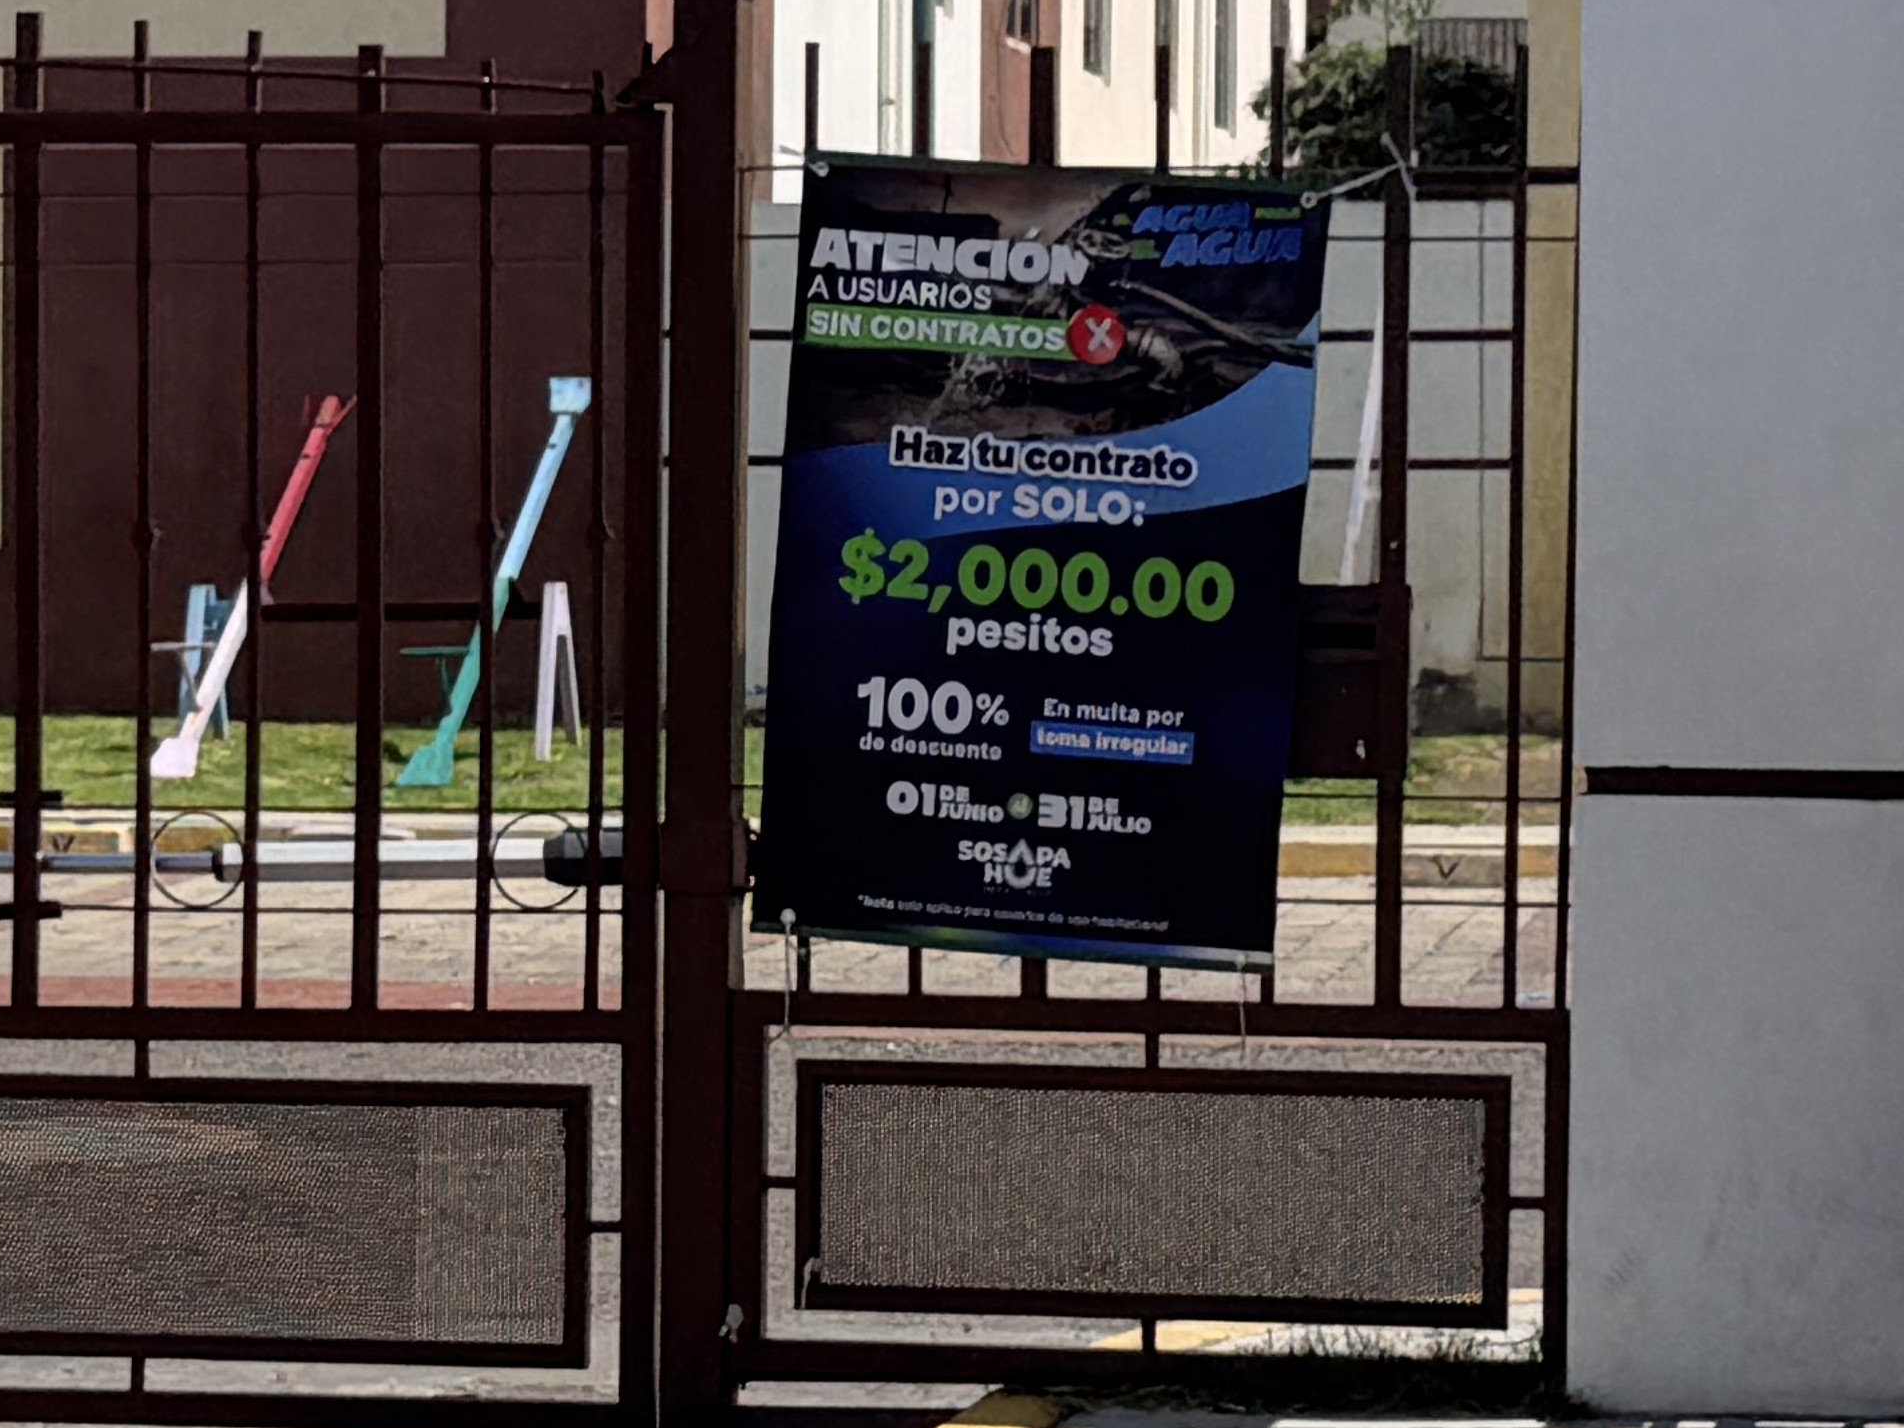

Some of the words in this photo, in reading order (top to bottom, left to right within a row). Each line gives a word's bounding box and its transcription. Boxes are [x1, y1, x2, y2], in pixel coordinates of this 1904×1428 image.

[809, 227, 1090, 286] ATENCIÓN
[807, 275, 830, 301] A
[837, 275, 993, 311] USUARIOS
[809, 310, 862, 337] SIN
[870, 313, 1067, 352] CONTRATOS
[892, 428, 967, 468] Haz
[974, 434, 1018, 471] tu
[1022, 442, 1196, 484] contrato
[934, 485, 1003, 521] por
[1013, 484, 1146, 527] SOLO:
[838, 527, 1235, 622] $2,000.00
[945, 613, 1114, 657] pesitos
[857, 676, 1010, 734] 100%
[1044, 698, 1070, 718] En
[1076, 702, 1140, 724] multa
[1146, 710, 1184, 728] por
[890, 735, 1002, 761] descuento
[1095, 731, 1190, 757] irregular
[886, 780, 937, 817] 01
[938, 802, 1005, 823] JUNIO
[939, 784, 970, 804] DE
[1038, 792, 1085, 830] 31
[1088, 796, 1120, 816] DE
[1087, 811, 1152, 835] JULIO
